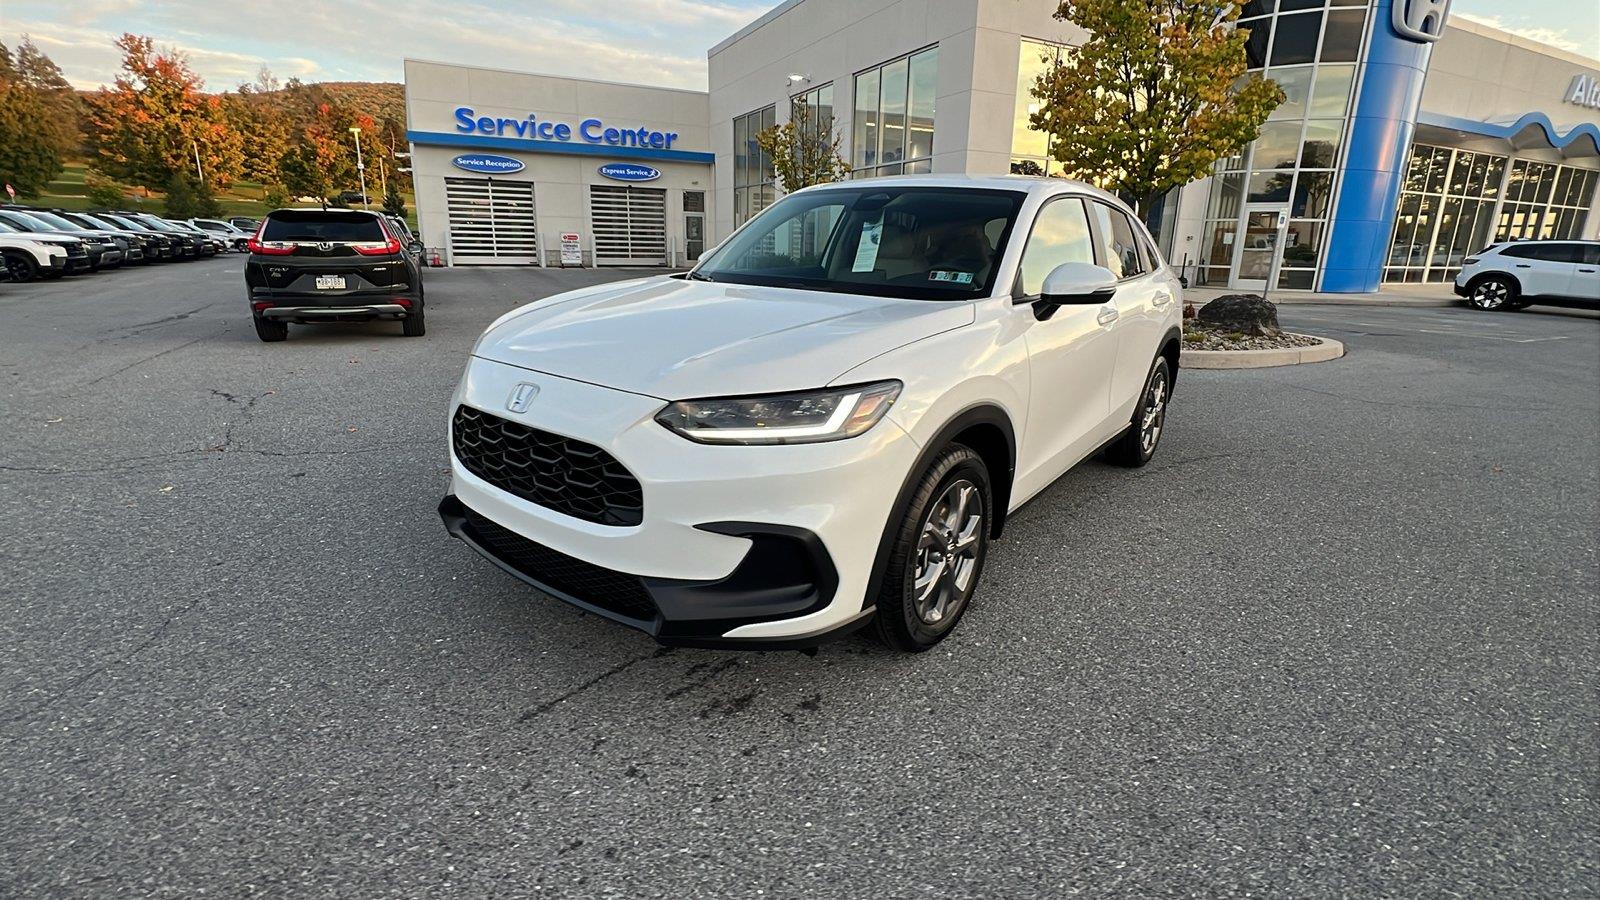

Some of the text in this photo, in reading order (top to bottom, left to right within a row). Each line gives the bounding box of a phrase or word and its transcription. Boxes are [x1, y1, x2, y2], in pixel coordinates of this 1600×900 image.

[454, 106, 678, 149] Service Center
[457, 157, 521, 169] Service Reception
[602, 167, 648, 176] Express Service
